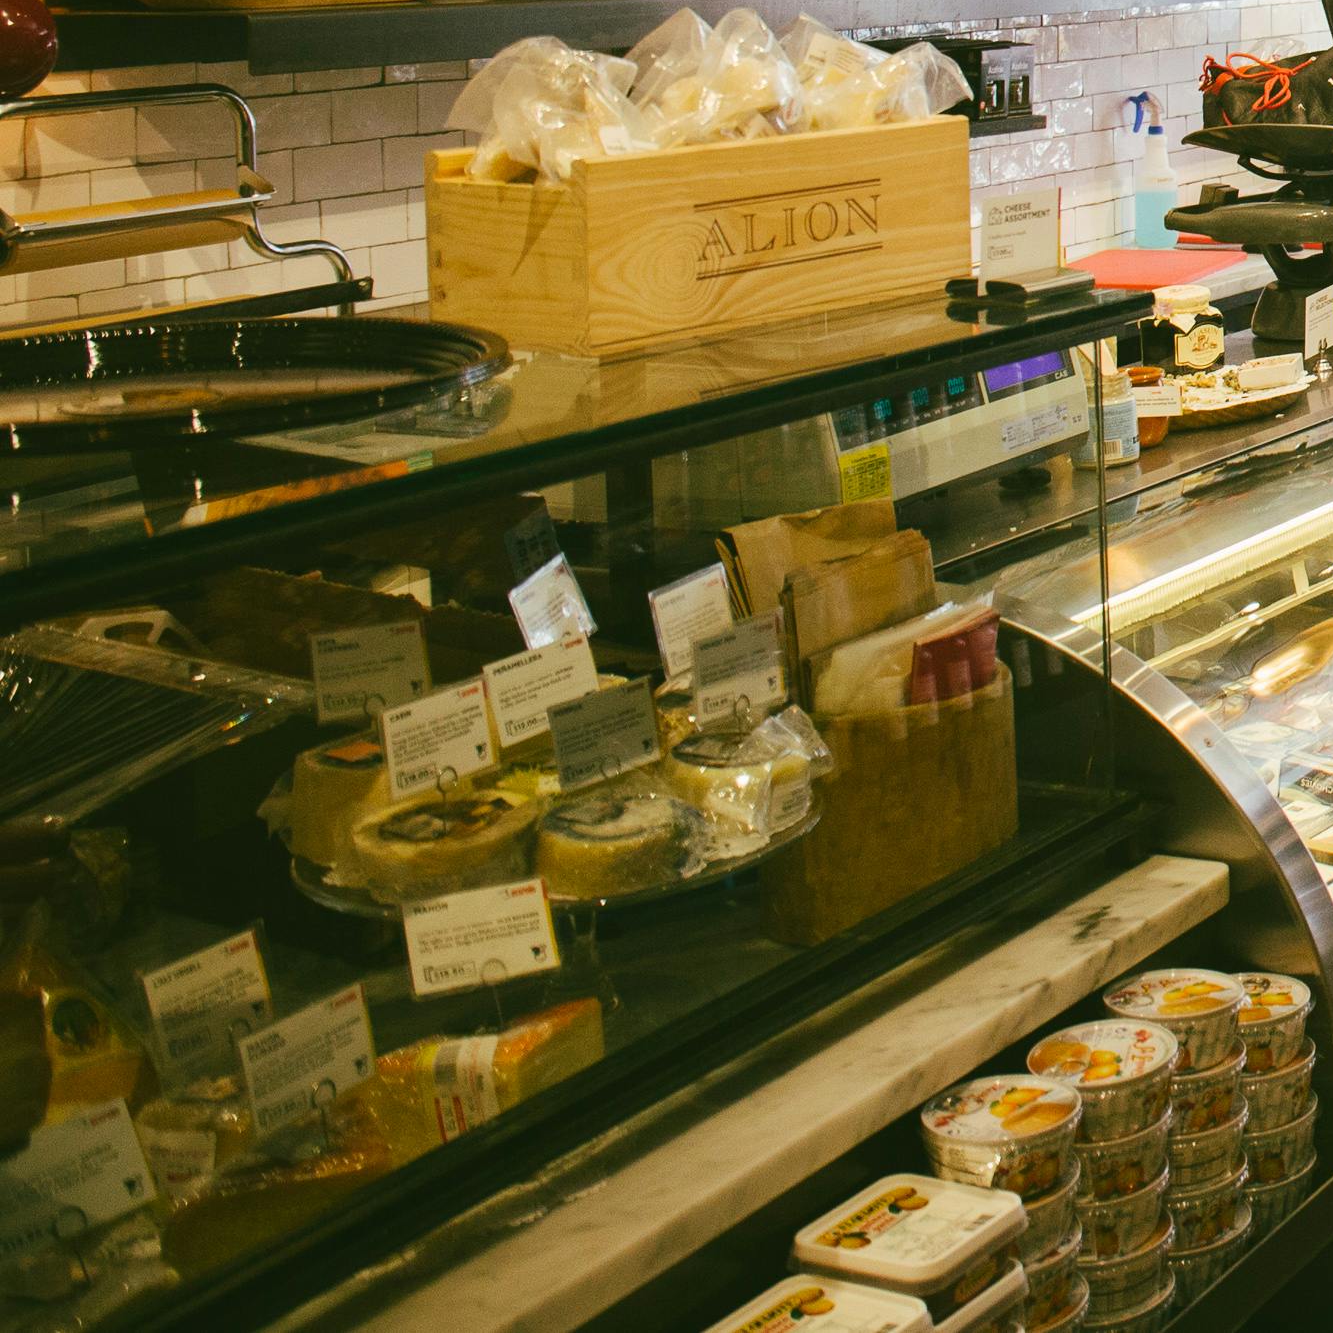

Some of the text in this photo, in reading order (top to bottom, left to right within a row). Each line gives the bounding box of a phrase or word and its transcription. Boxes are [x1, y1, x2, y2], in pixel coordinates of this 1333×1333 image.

[1004, 202, 1032, 214] CHEESE
[1004, 208, 1051, 223] ASSORTMENT
[697, 193, 882, 262] ALION
